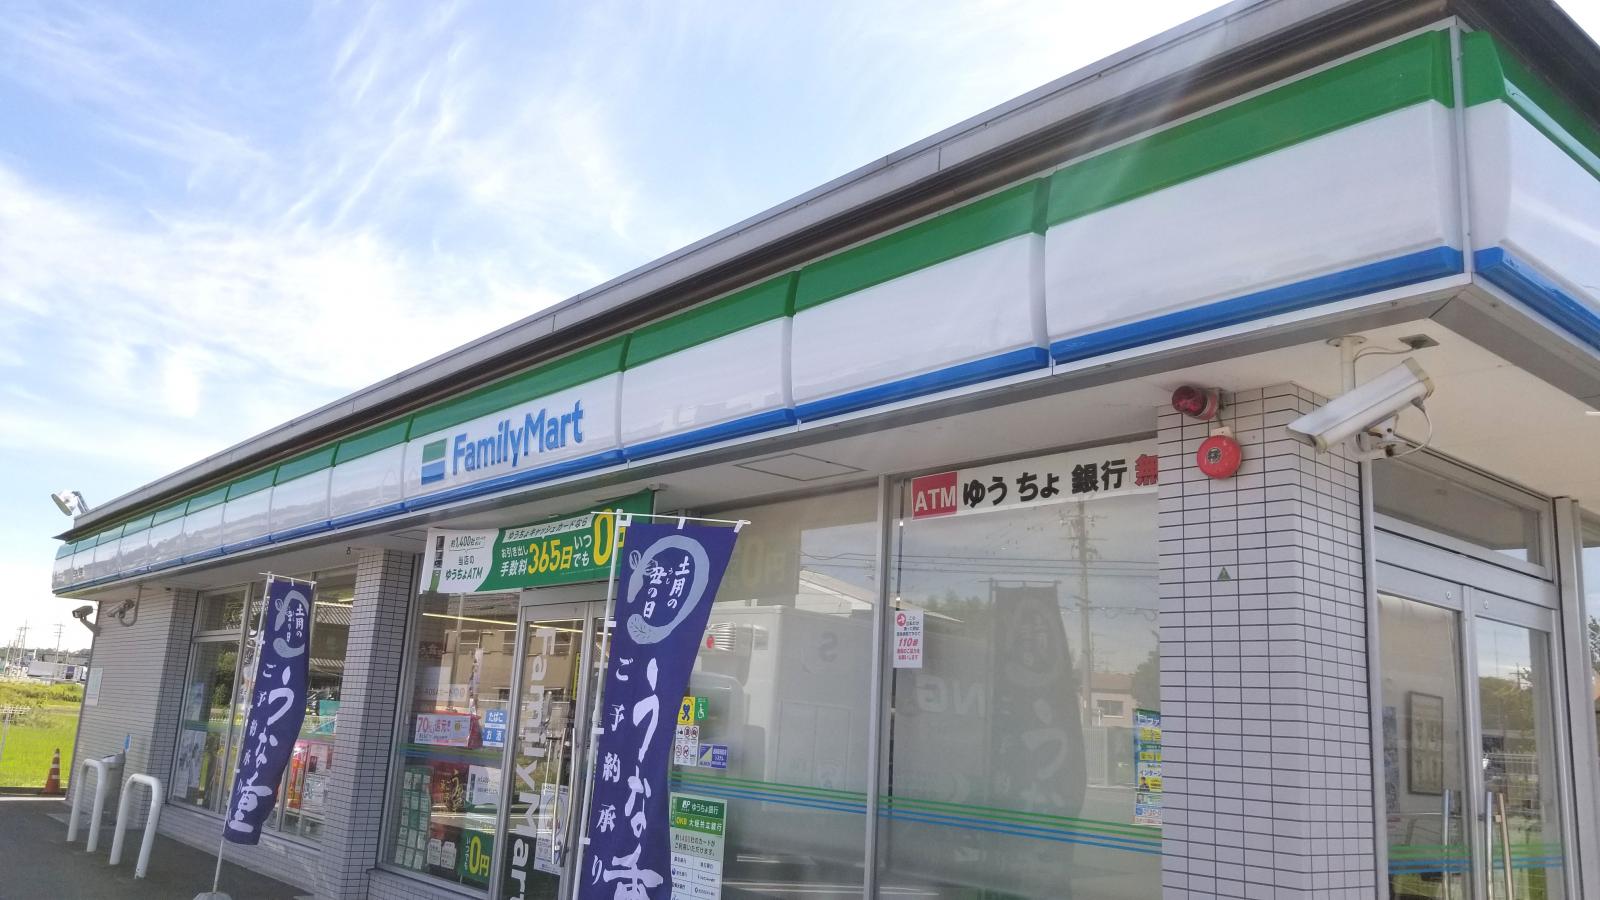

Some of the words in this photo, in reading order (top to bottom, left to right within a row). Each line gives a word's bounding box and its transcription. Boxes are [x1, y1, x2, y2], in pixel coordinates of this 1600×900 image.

[452, 400, 584, 475] FamilyMart
[914, 485, 956, 512] ATM
[963, 459, 1128, 507] ゆうちょ銀行
[501, 545, 529, 558] お引き出し
[527, 539, 573, 574] 365日
[573, 534, 592, 550] いつ
[573, 550, 590, 568] でも
[445, 566, 484, 581] ゆうちょATM
[500, 558, 528, 577] 手数料
[667, 555, 690, 609] 土用の
[643, 566, 667, 618] 丑の日
[295, 603, 305, 638] 土用の
[488, 711, 504, 723] たばこ
[228, 666, 295, 833] うな重
[591, 657, 633, 886] ご予約承り
[691, 803, 719, 815] ゆうちょ銀行
[469, 836, 490, 877] 0円
